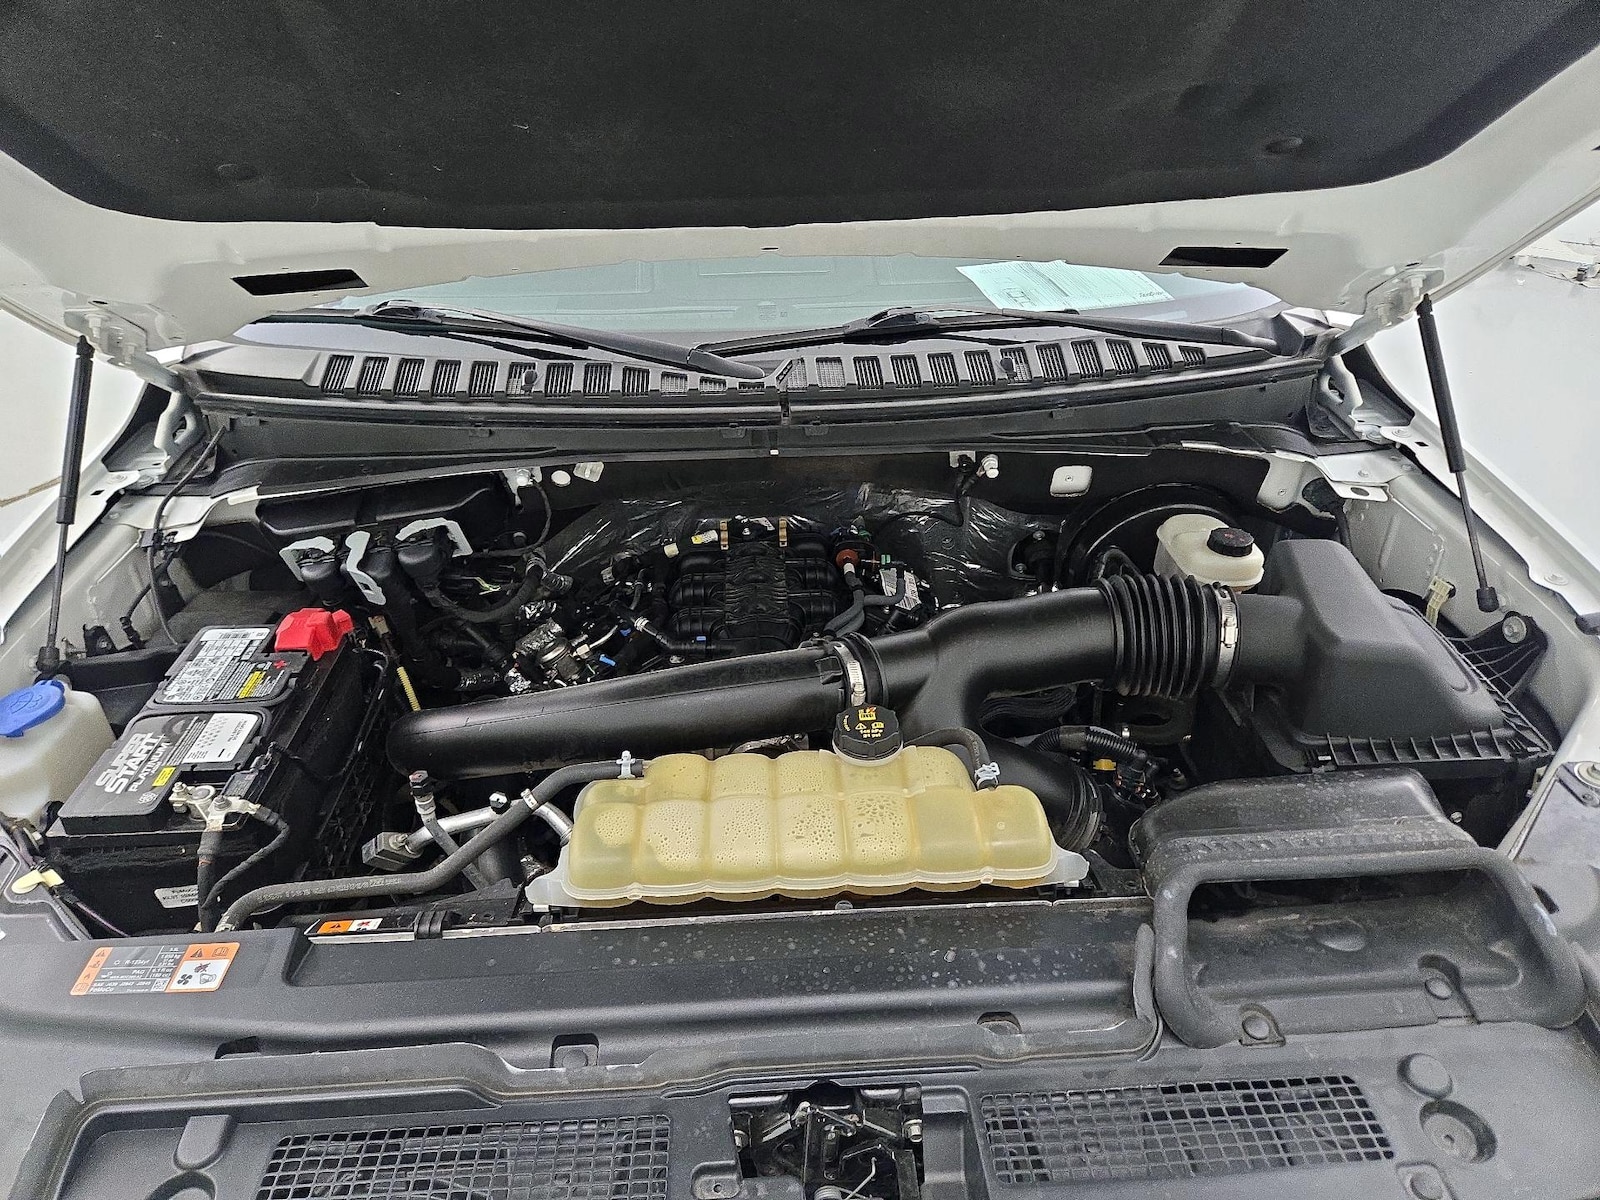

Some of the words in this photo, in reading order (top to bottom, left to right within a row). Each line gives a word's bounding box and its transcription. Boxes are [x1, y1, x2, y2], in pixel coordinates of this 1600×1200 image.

[95, 733, 147, 786] SUPER
[104, 732, 159, 794] START
[128, 742, 172, 792] PLATINUM
